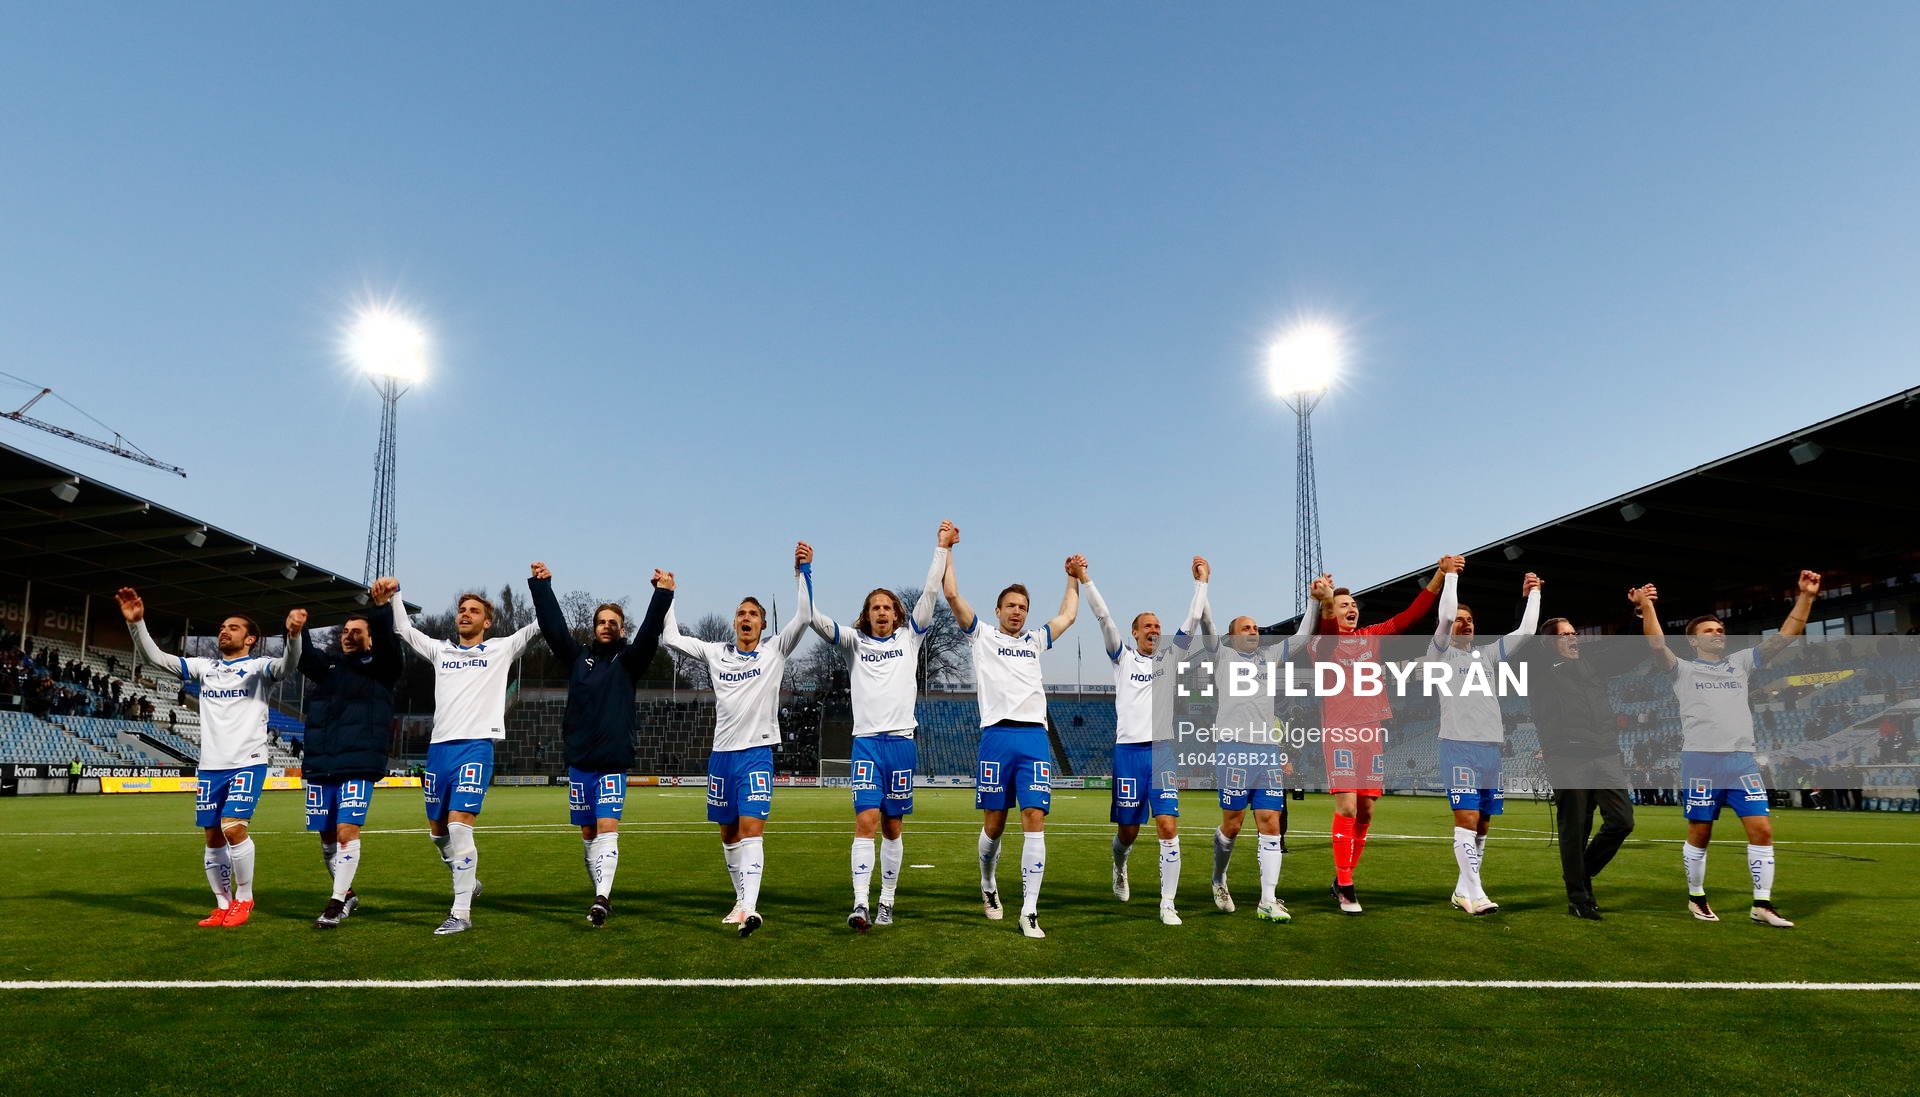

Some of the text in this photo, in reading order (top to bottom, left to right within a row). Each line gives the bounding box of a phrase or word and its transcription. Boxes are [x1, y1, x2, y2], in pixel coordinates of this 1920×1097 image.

[861, 648, 903, 662] HOLMEN
[998, 648, 1036, 659] HOLMEN
[441, 659, 488, 669] HOLMEN
[719, 667, 761, 682] HOLMEN
[202, 688, 249, 698] HOLMEN
[14, 764, 37, 777] kvm
[48, 765, 69, 777] kvm
[82, 765, 111, 777] LÄGGER
[113, 768, 132, 777] GOLV
[140, 766, 161, 777] SÄTTER
[1222, 794, 1231, 805] 20
[1451, 795, 1461, 804] 19
